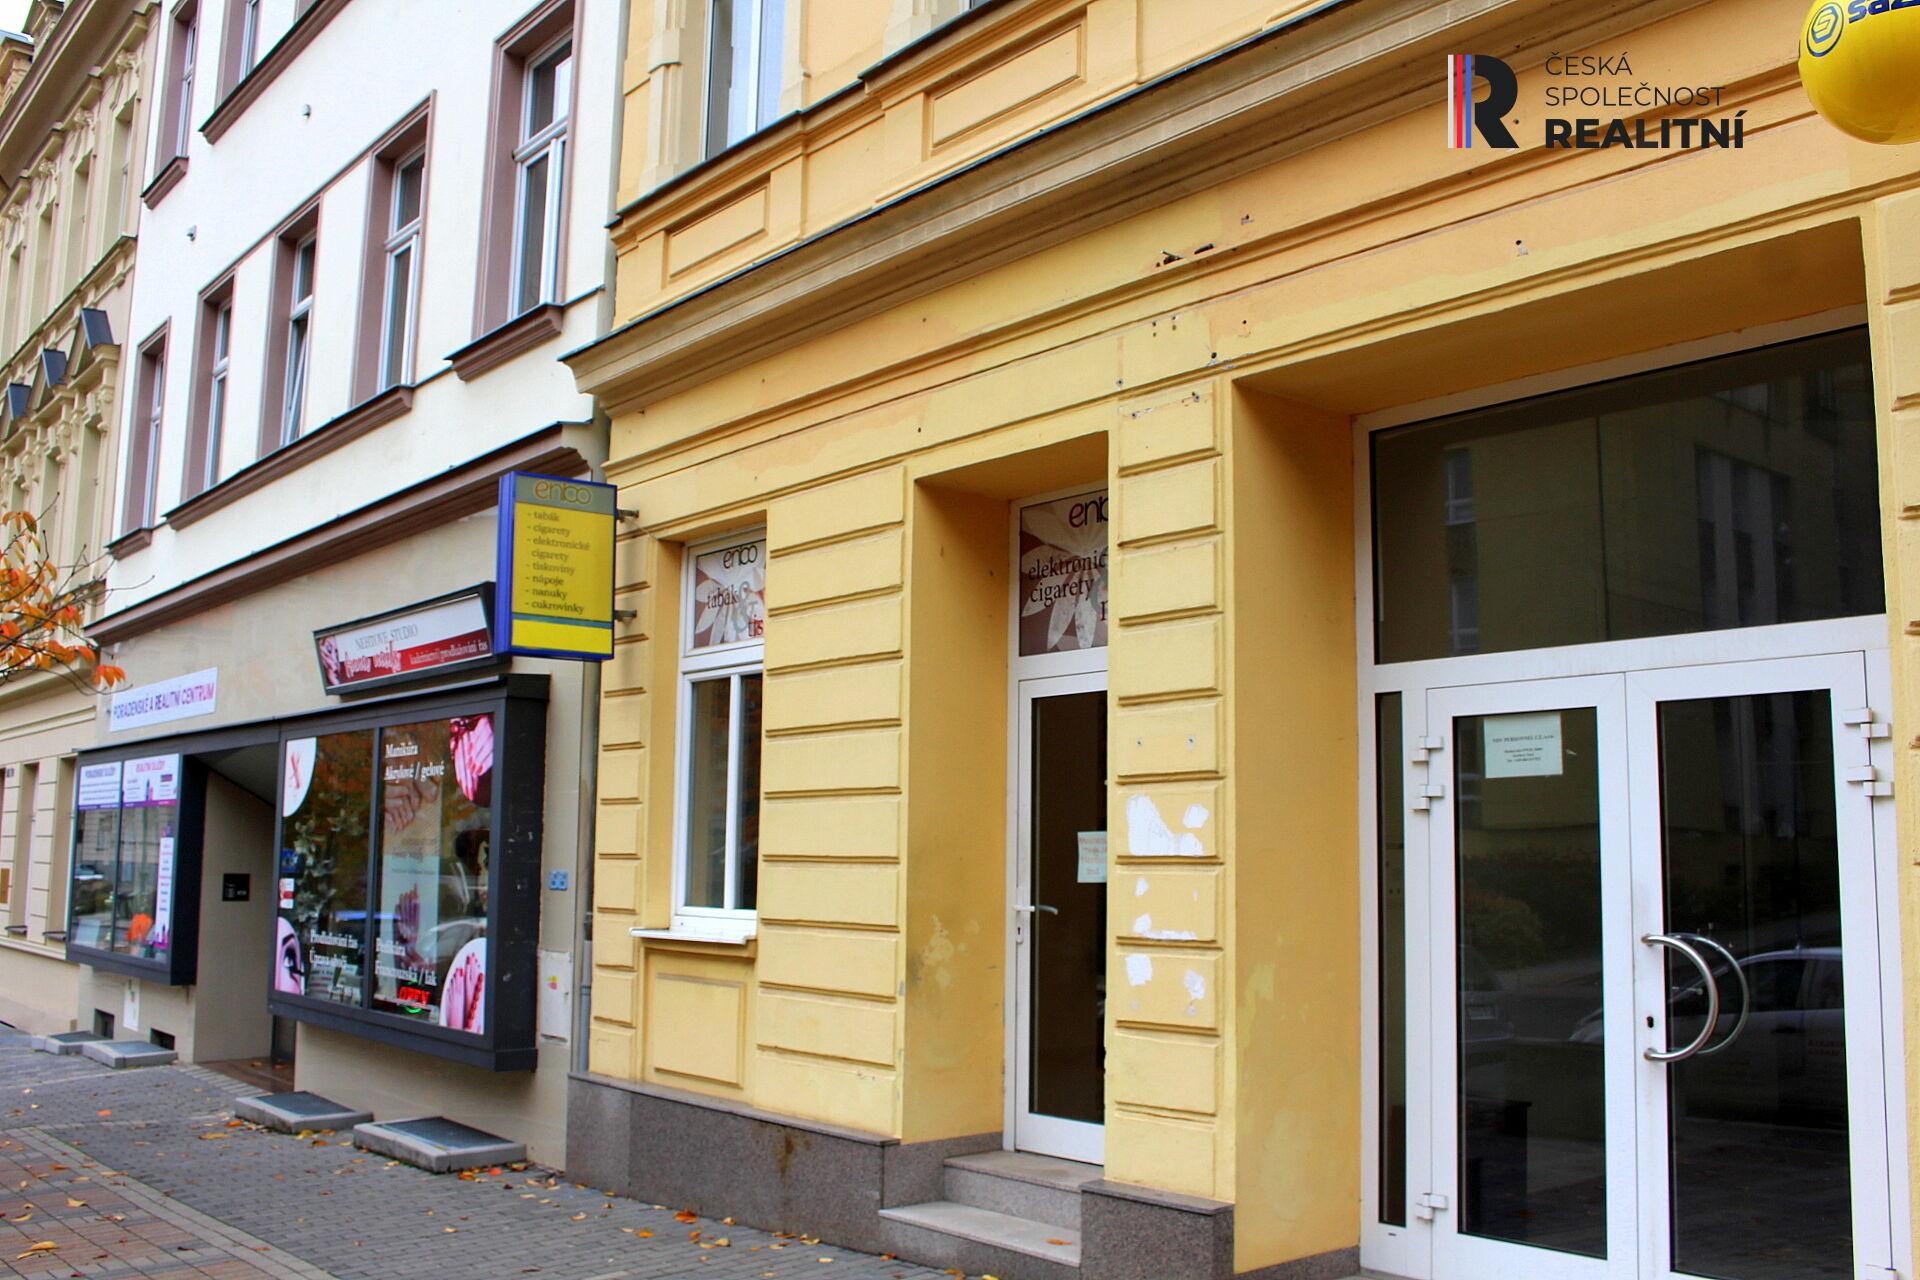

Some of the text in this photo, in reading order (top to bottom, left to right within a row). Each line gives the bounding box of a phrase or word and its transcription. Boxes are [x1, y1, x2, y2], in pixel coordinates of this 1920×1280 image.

[533, 523, 571, 537] cigarety
[532, 536, 590, 551] elektronické
[531, 549, 570, 562] cigarety
[532, 561, 575, 575] tiskoviny
[532, 587, 568, 601] nanuky
[1030, 577, 1095, 608] cigarety
[531, 600, 584, 615] cukrovinky
[421, 760, 445, 783] gelové
